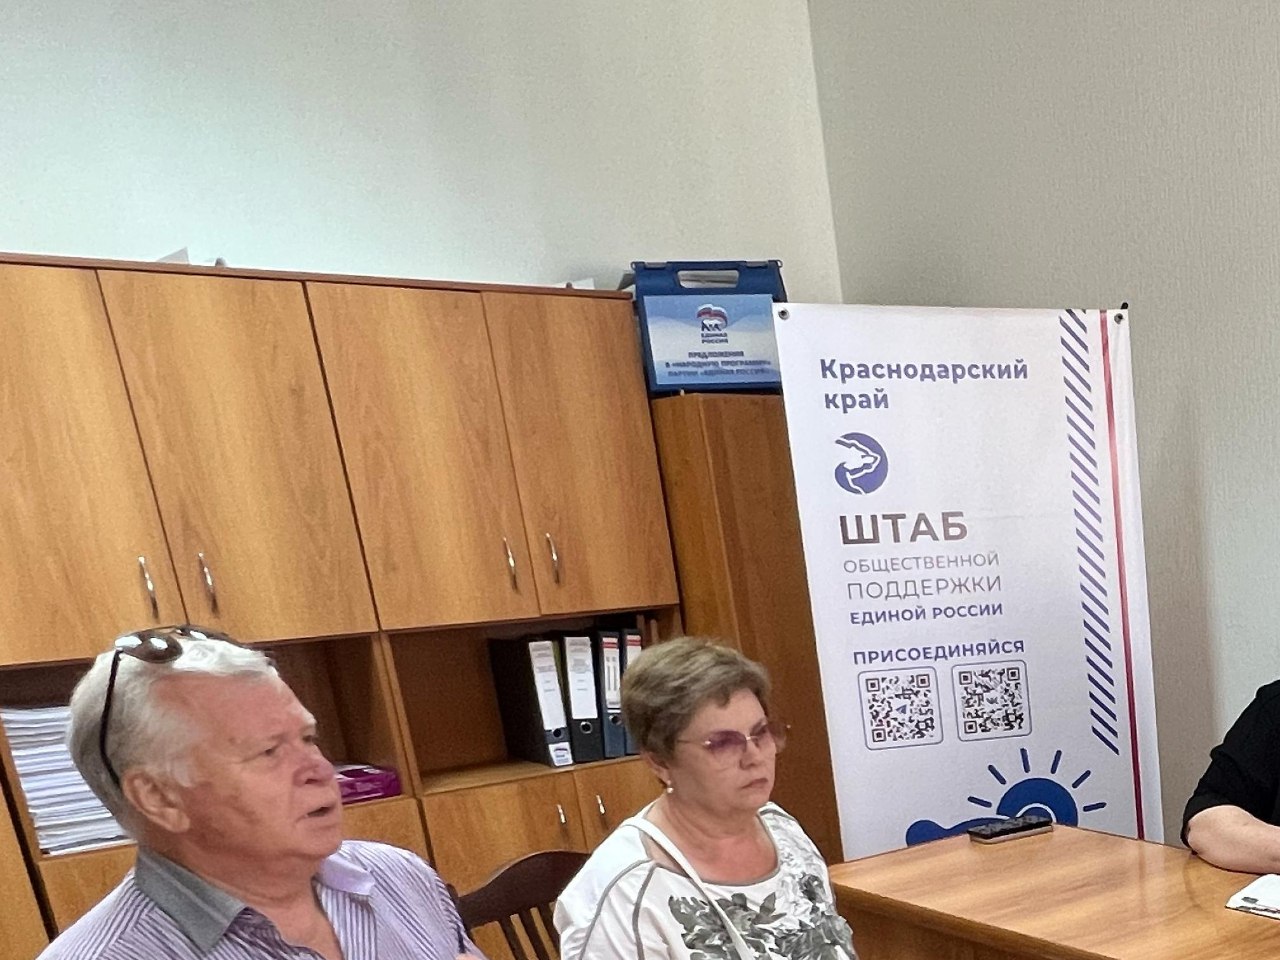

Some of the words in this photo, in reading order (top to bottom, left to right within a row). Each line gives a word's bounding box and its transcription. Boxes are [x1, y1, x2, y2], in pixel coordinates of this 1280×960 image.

[820, 358, 1028, 384] Краснодарский
[824, 387, 889, 414] край
[839, 511, 968, 545] ШТАБ
[843, 551, 1000, 573] ОБЩЕСТВЕННОЙ
[847, 575, 1002, 600] ПОДДЕРЖКИ
[850, 605, 926, 626] ЕДИНОЙ
[932, 603, 1003, 619] РОССИИ
[853, 638, 1025, 665] ПРИСОЕДИНЯЙСЯ
